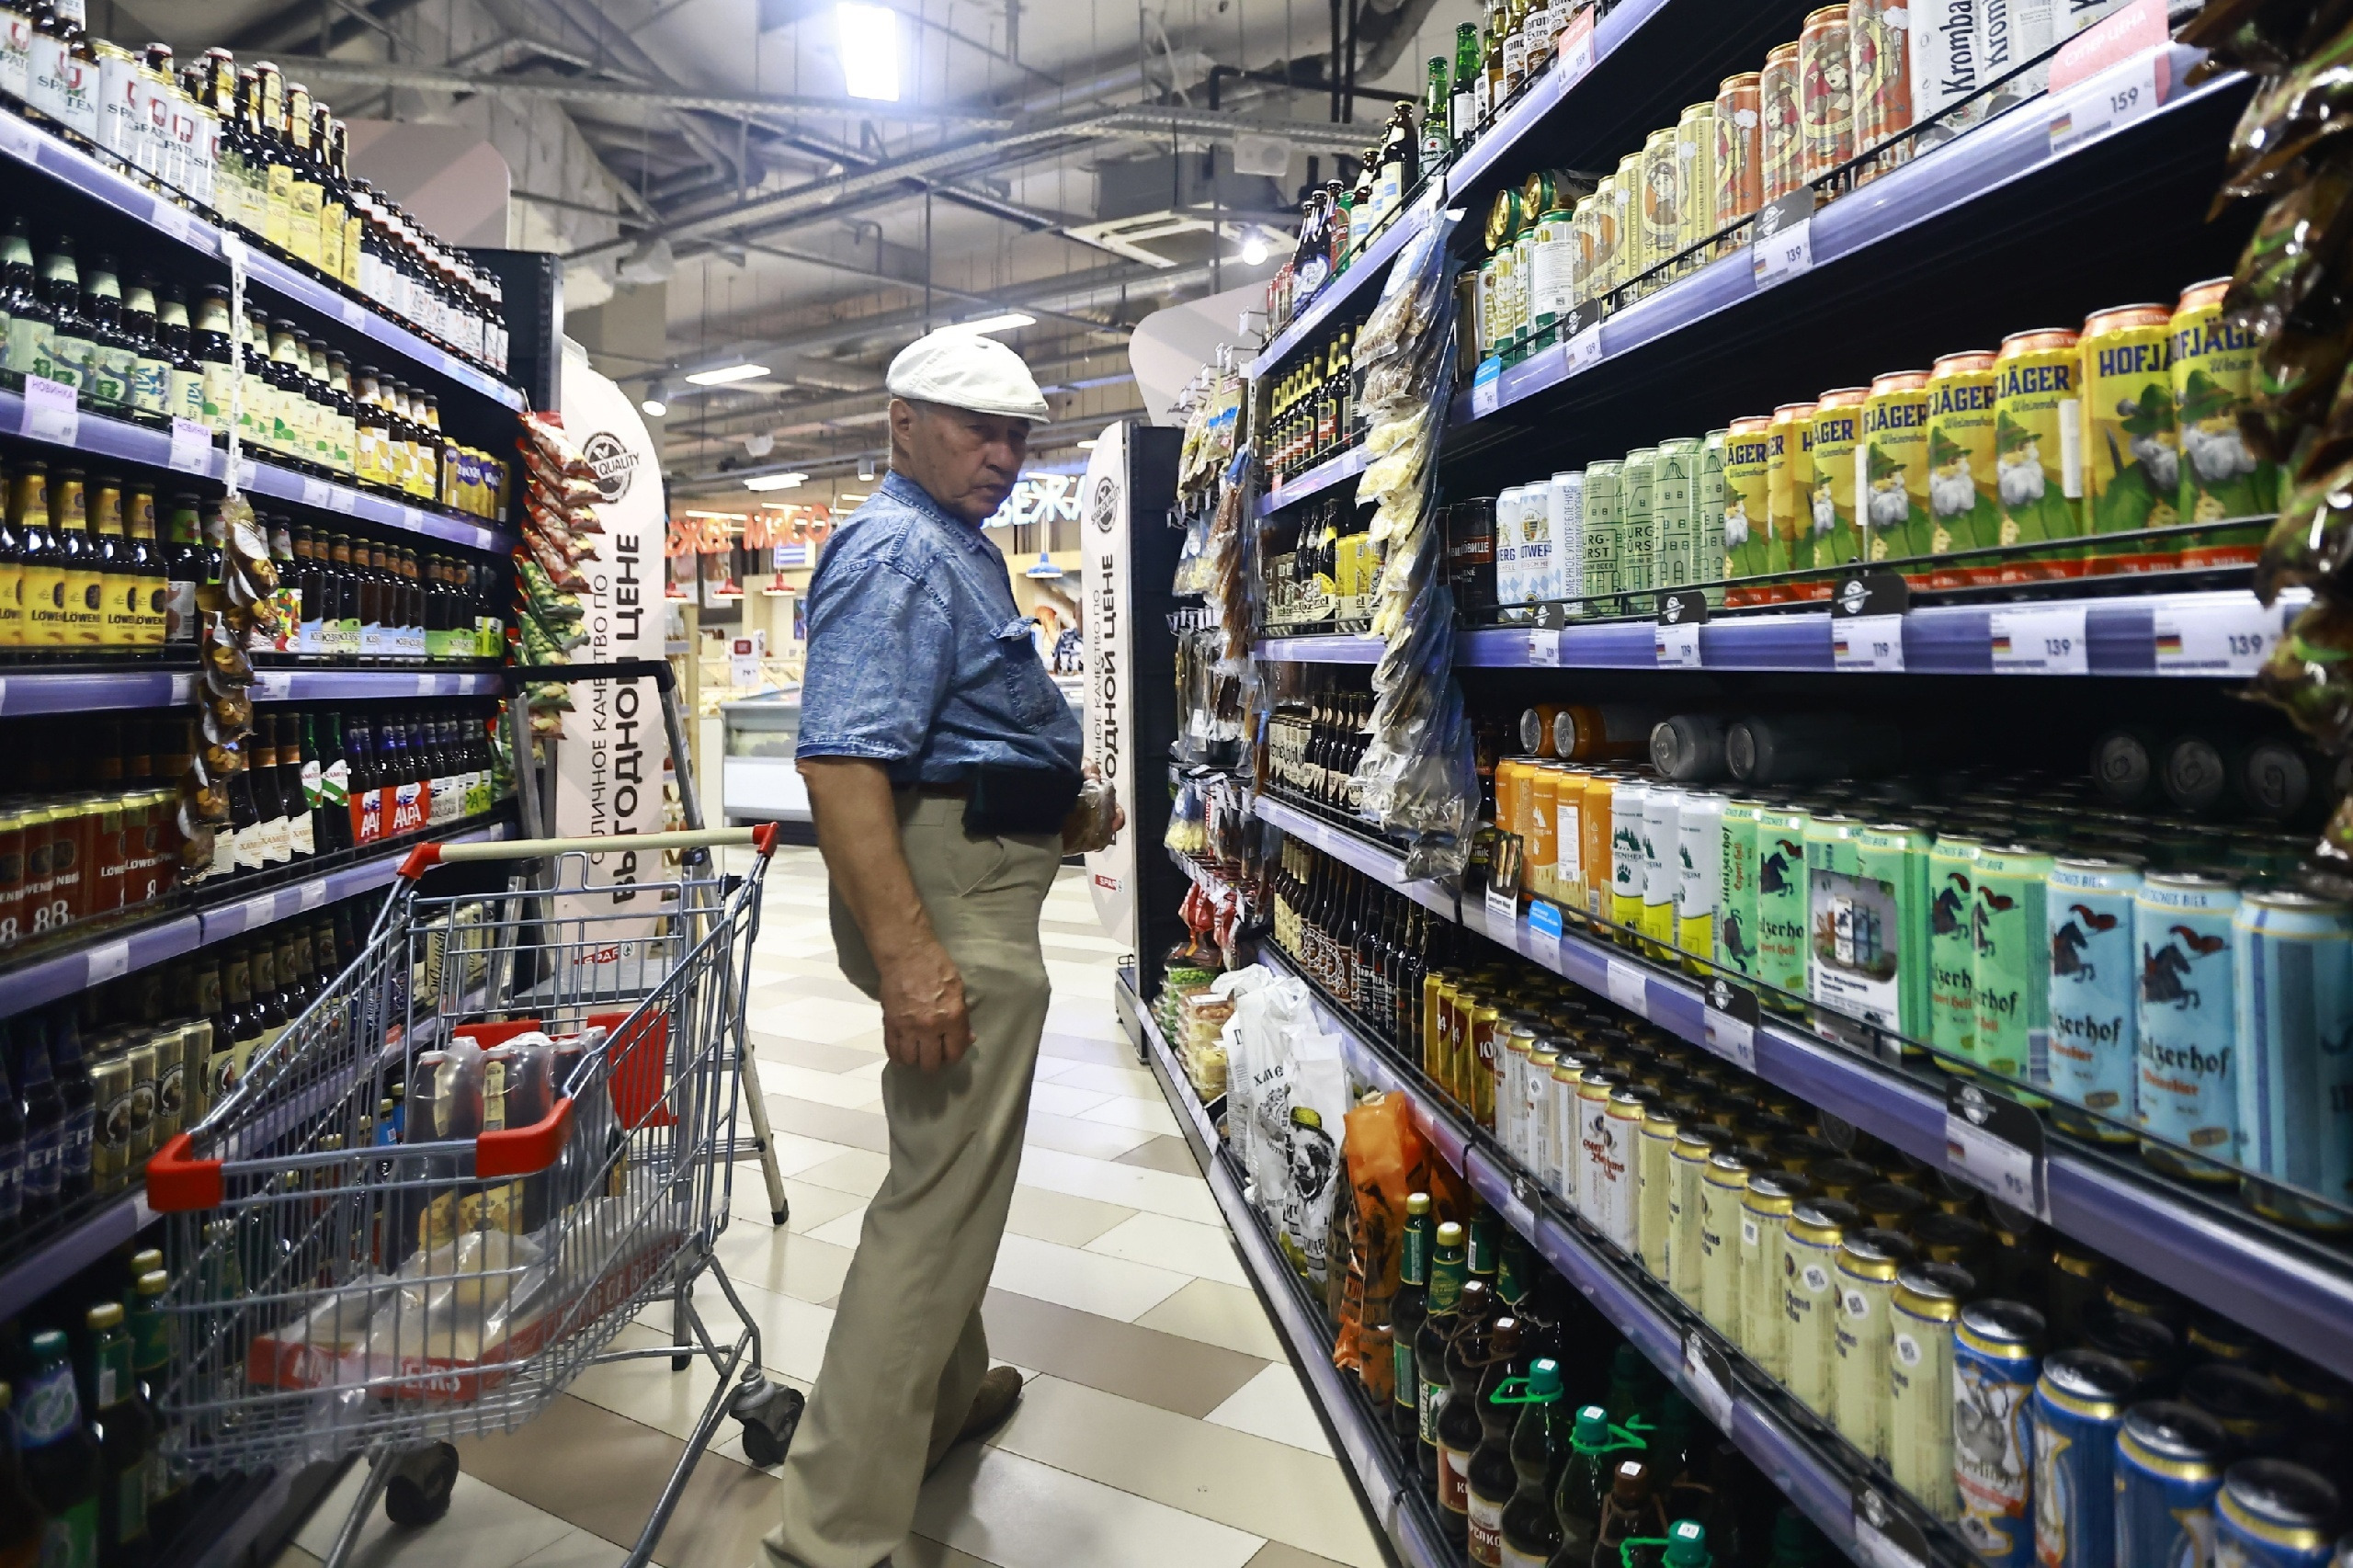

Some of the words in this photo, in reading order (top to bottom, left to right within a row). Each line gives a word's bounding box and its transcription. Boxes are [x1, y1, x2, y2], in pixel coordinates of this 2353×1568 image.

[2110, 87, 2139, 113] 159
[1786, 244, 1802, 263] 139
[31, 380, 74, 401] НОВИНКА
[176, 422, 210, 438] НОВИНКА
[744, 503, 831, 551] МЯСО
[1564, 487, 1575, 553] УПОТРЕБЛЕНИЕ
[1596, 562, 1614, 570] BEER
[594, 575, 607, 608] ПО
[616, 534, 643, 641] ЦЕНЕ
[1101, 553, 1117, 639] ЦЕНЕ
[1564, 556, 1575, 612] ЧЗМЕРНОЕ
[1094, 590, 1101, 616] ПО
[1873, 642, 1889, 657] 119
[2045, 639, 2072, 656] 139
[2228, 635, 2264, 655] 139
[593, 617, 607, 731] КАЧЕТВО
[591, 739, 607, 866] ОЛИЧНОЕ
